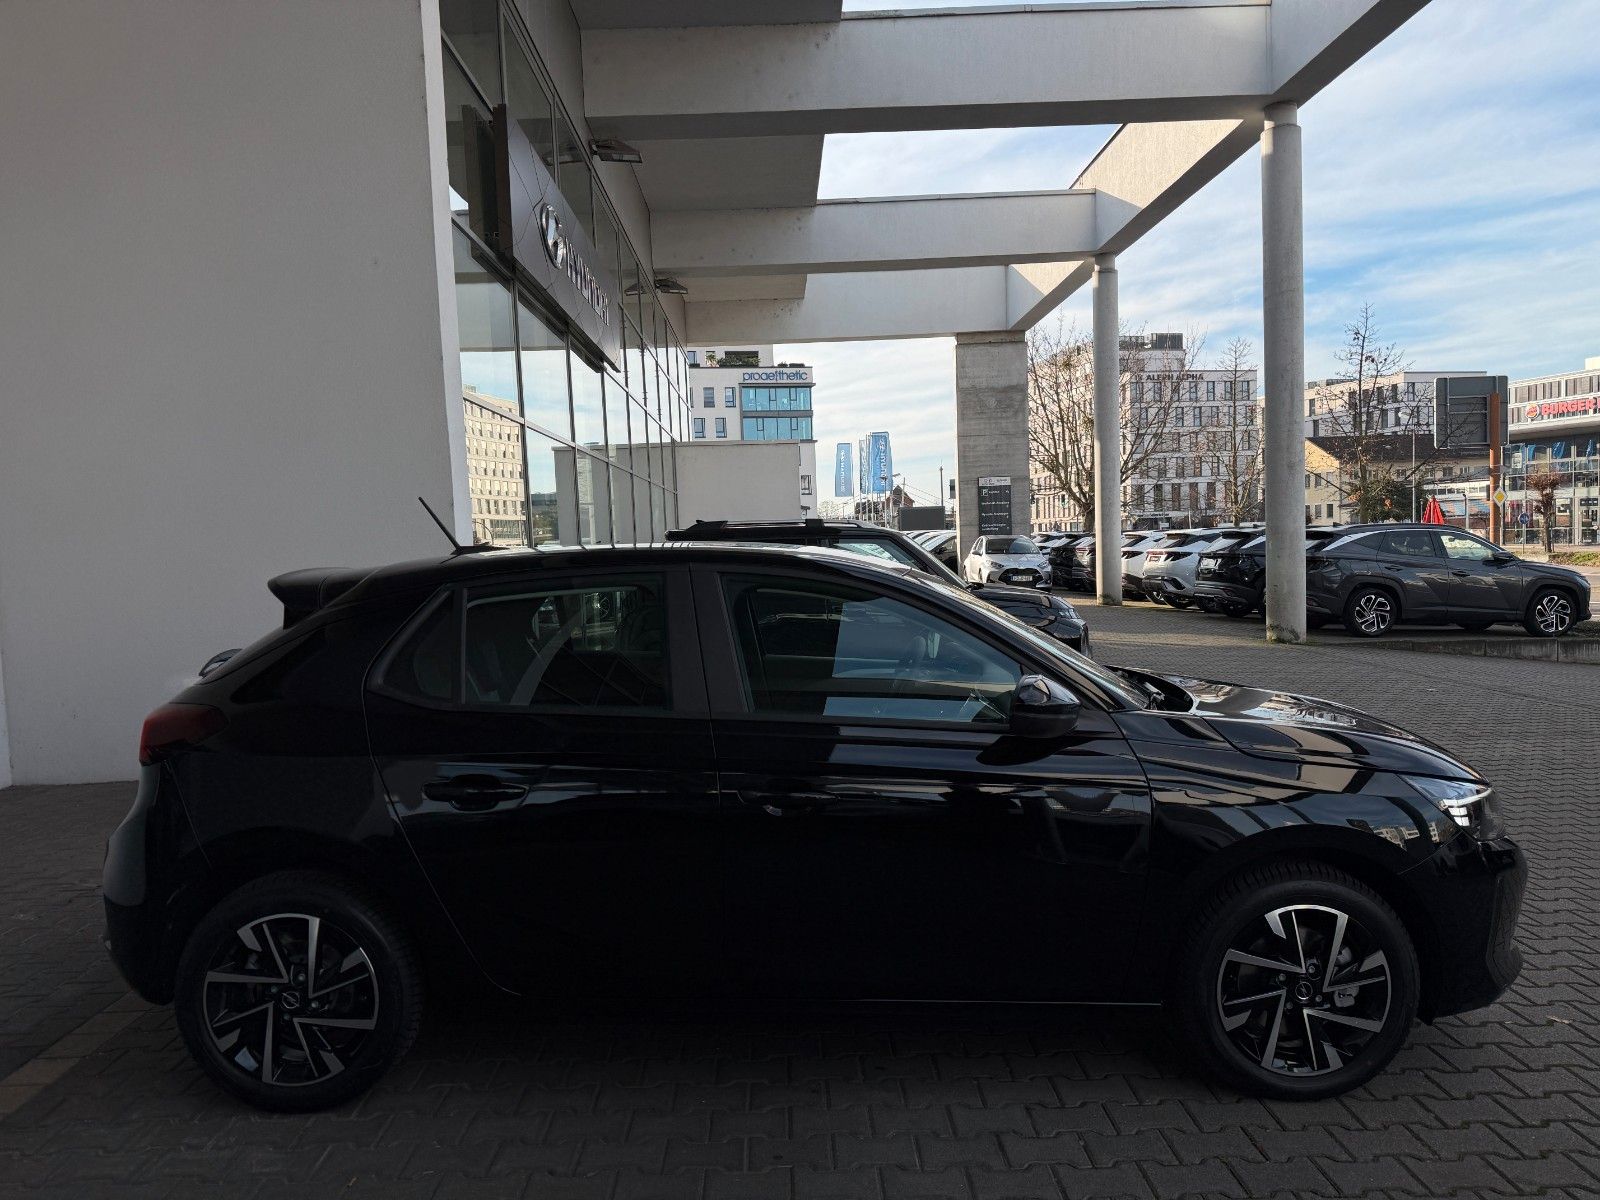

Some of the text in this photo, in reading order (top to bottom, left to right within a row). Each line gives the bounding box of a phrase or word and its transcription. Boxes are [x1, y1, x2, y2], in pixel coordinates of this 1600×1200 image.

[1146, 373, 1204, 381] ALEPH ALPHA
[1541, 398, 1596, 416] BURGER
